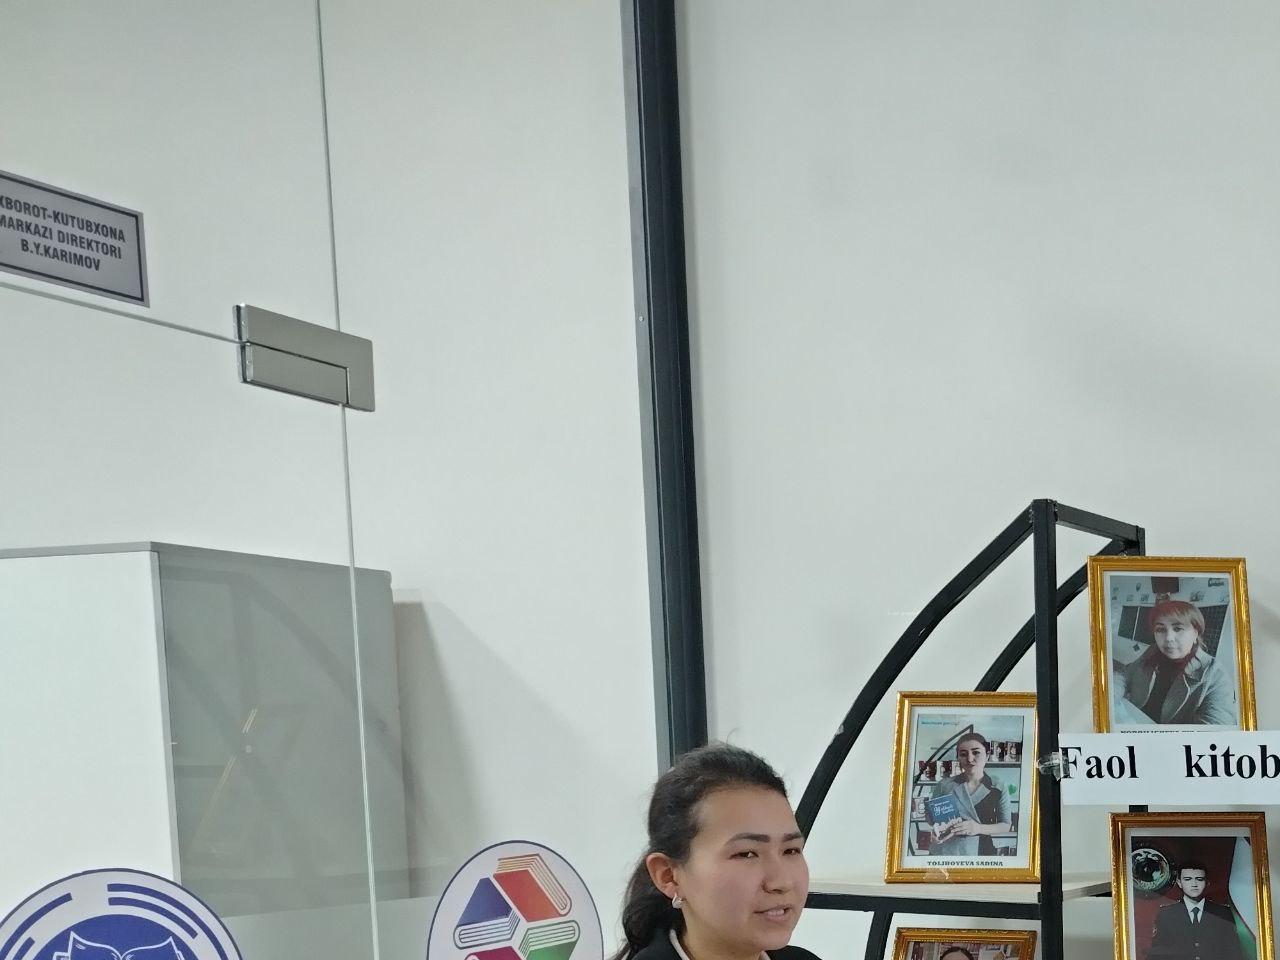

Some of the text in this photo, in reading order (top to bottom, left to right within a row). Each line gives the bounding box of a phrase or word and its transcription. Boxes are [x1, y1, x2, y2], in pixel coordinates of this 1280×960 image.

[21, 238, 100, 271] B.Y.KARIMOV
[57, 229, 121, 259] DIREKTORI
[1060, 745, 1140, 780] Faol
